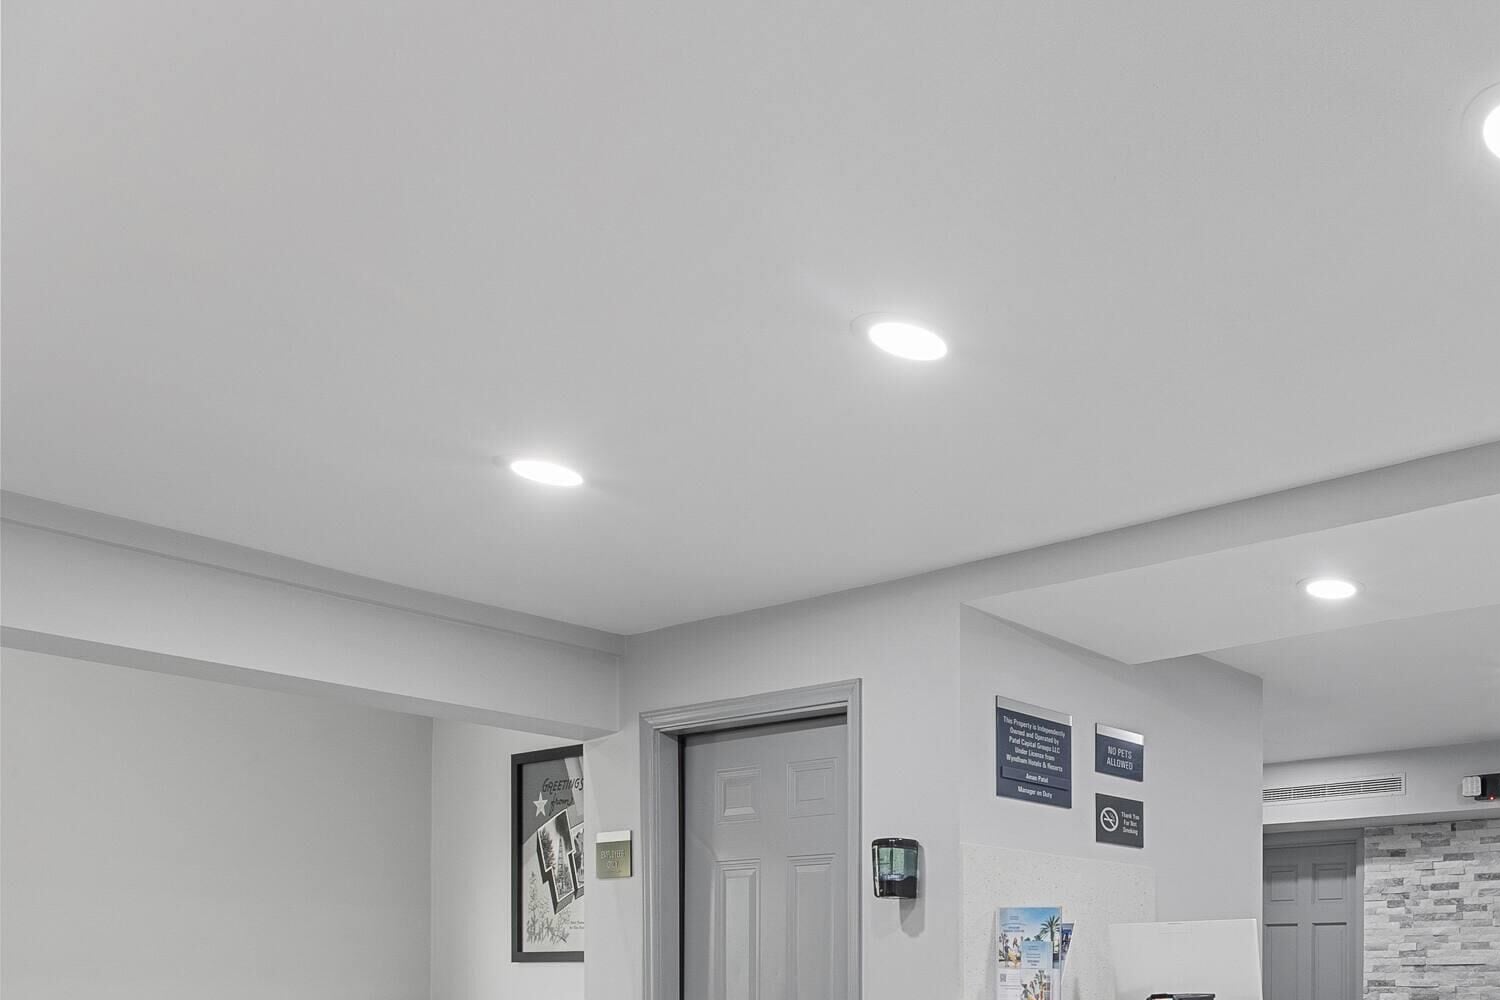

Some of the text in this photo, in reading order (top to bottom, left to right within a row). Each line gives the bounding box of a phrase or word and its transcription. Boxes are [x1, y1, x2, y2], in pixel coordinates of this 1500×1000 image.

[1003, 716, 1013, 724] This
[1014, 718, 1032, 729] Property
[1037, 725, 1065, 738] Independently
[1010, 726, 1025, 736] Owned
[1035, 733, 1053, 744] Operated
[1015, 746, 1028, 755] Under
[1108, 746, 1132, 759] NO PETS
[1006, 754, 1027, 764] Wyndham
[1028, 758, 1042, 768] Hotels
[1106, 757, 1133, 770] ALLOWED
[542, 777, 584, 795] GREETINGS
[1018, 786, 1036, 795] Manager
[1121, 811, 1132, 819] Thank
[1122, 827, 1138, 836] Smoking
